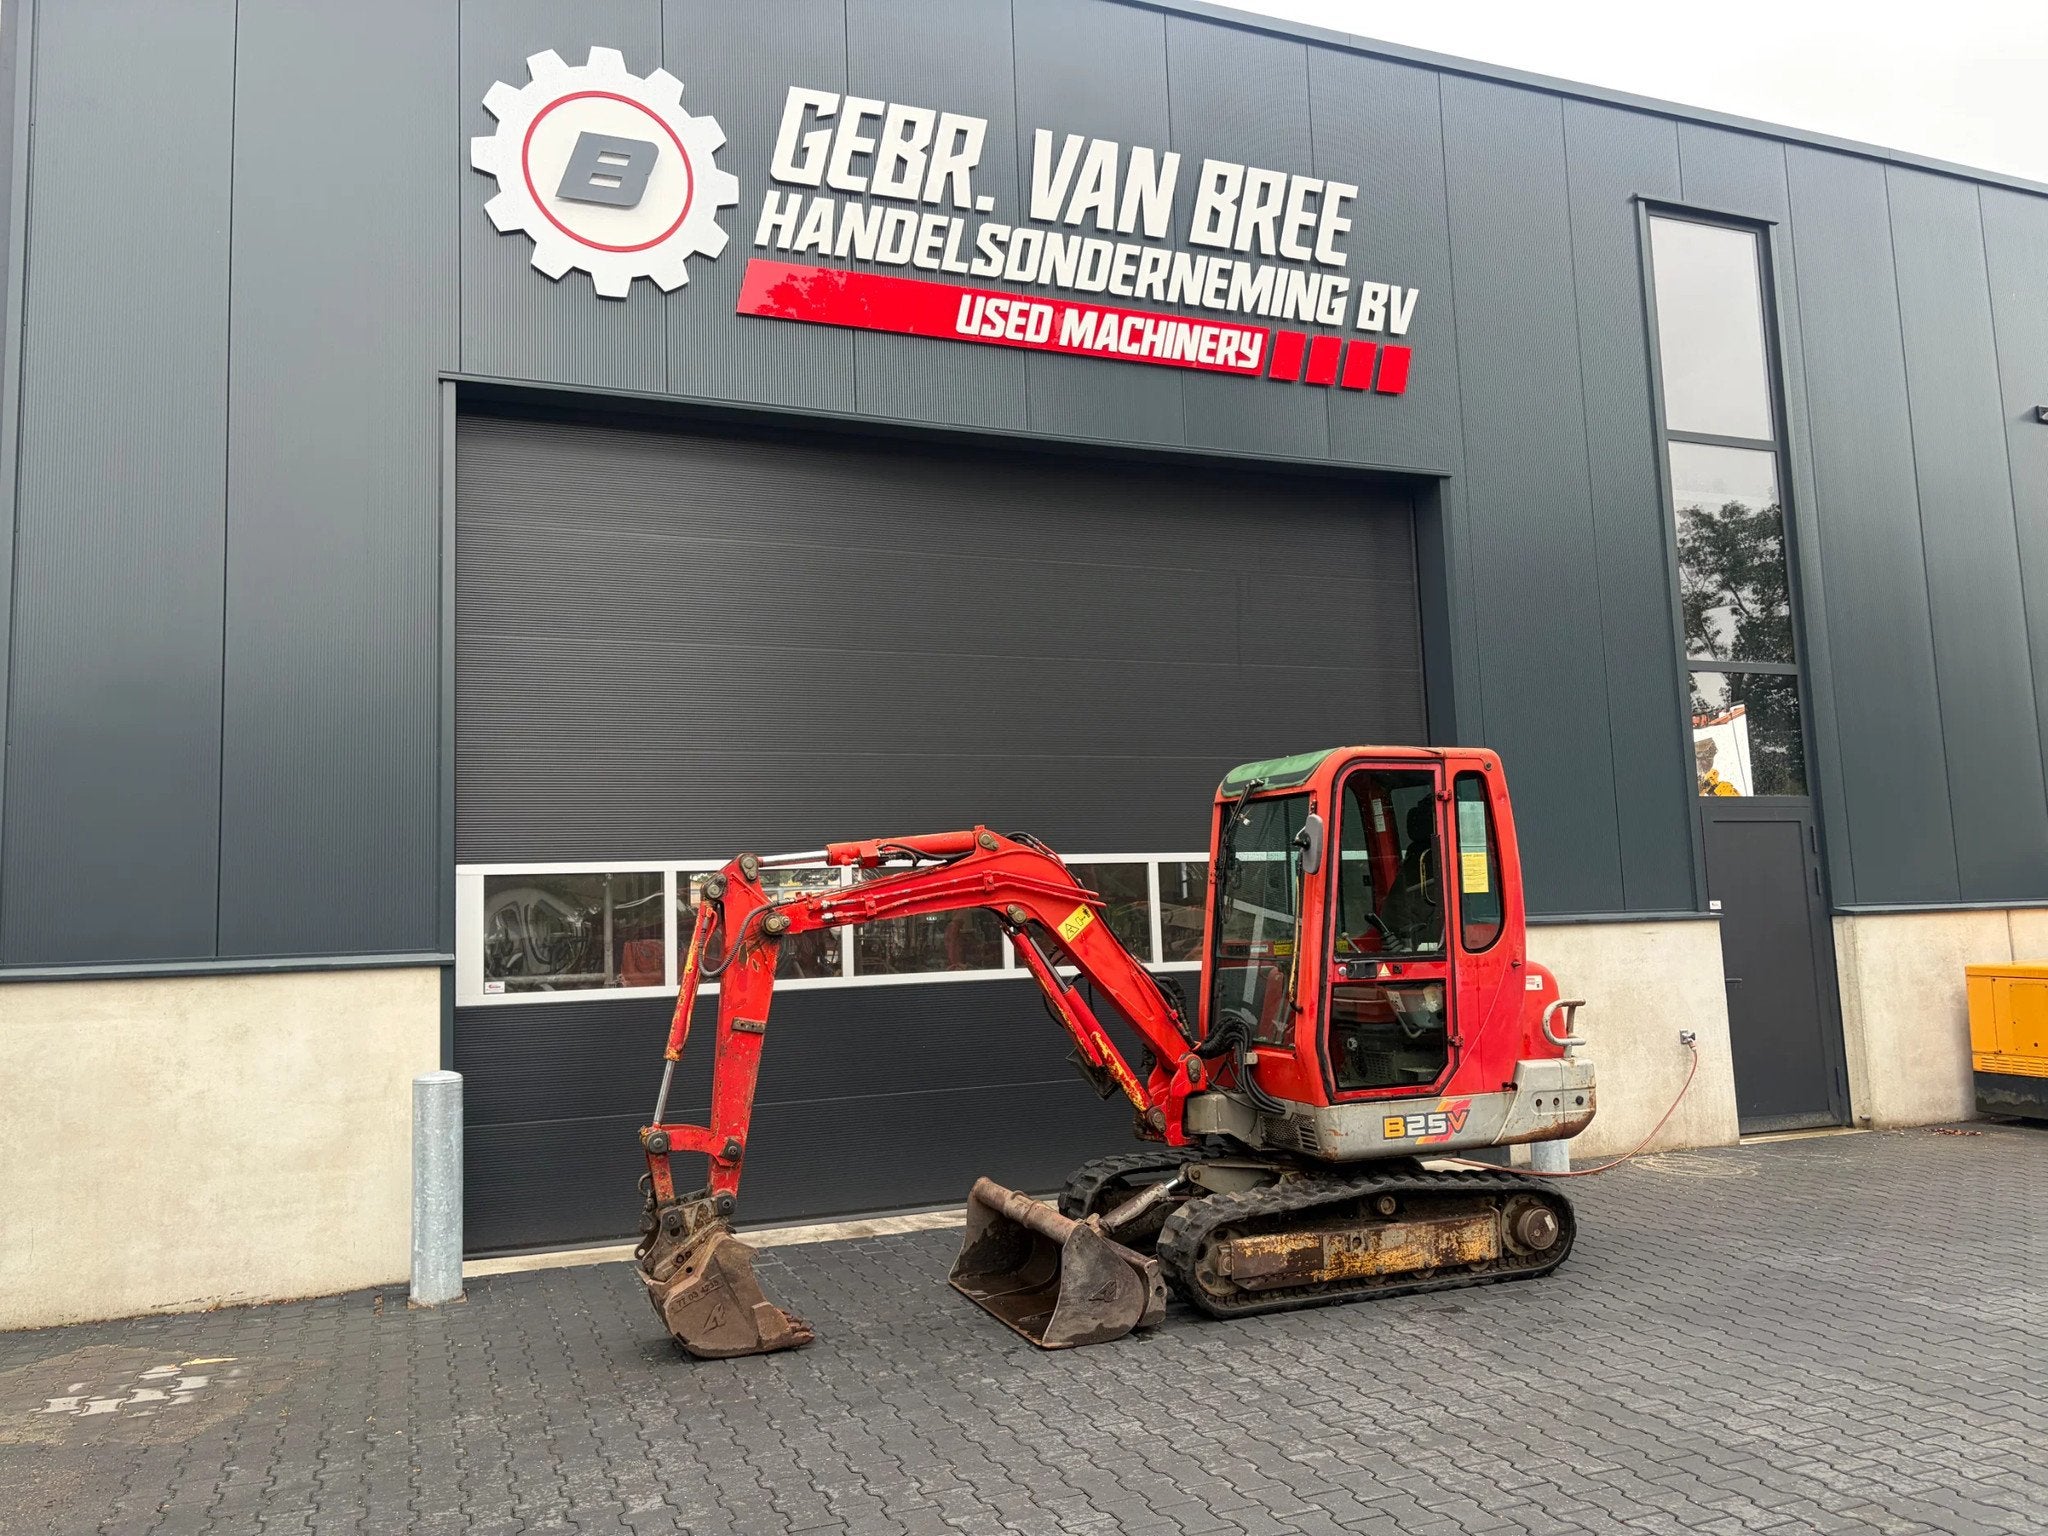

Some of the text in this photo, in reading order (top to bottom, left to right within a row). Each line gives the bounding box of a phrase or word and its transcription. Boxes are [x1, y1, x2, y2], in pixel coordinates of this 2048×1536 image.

[770, 86, 1358, 266] GEBR. VAN BREE
[754, 190, 1419, 334] HANDELSONDERNEMING BV
[956, 294, 1263, 370] USED MACHINERY
[1383, 1109, 1470, 1140] B25V
